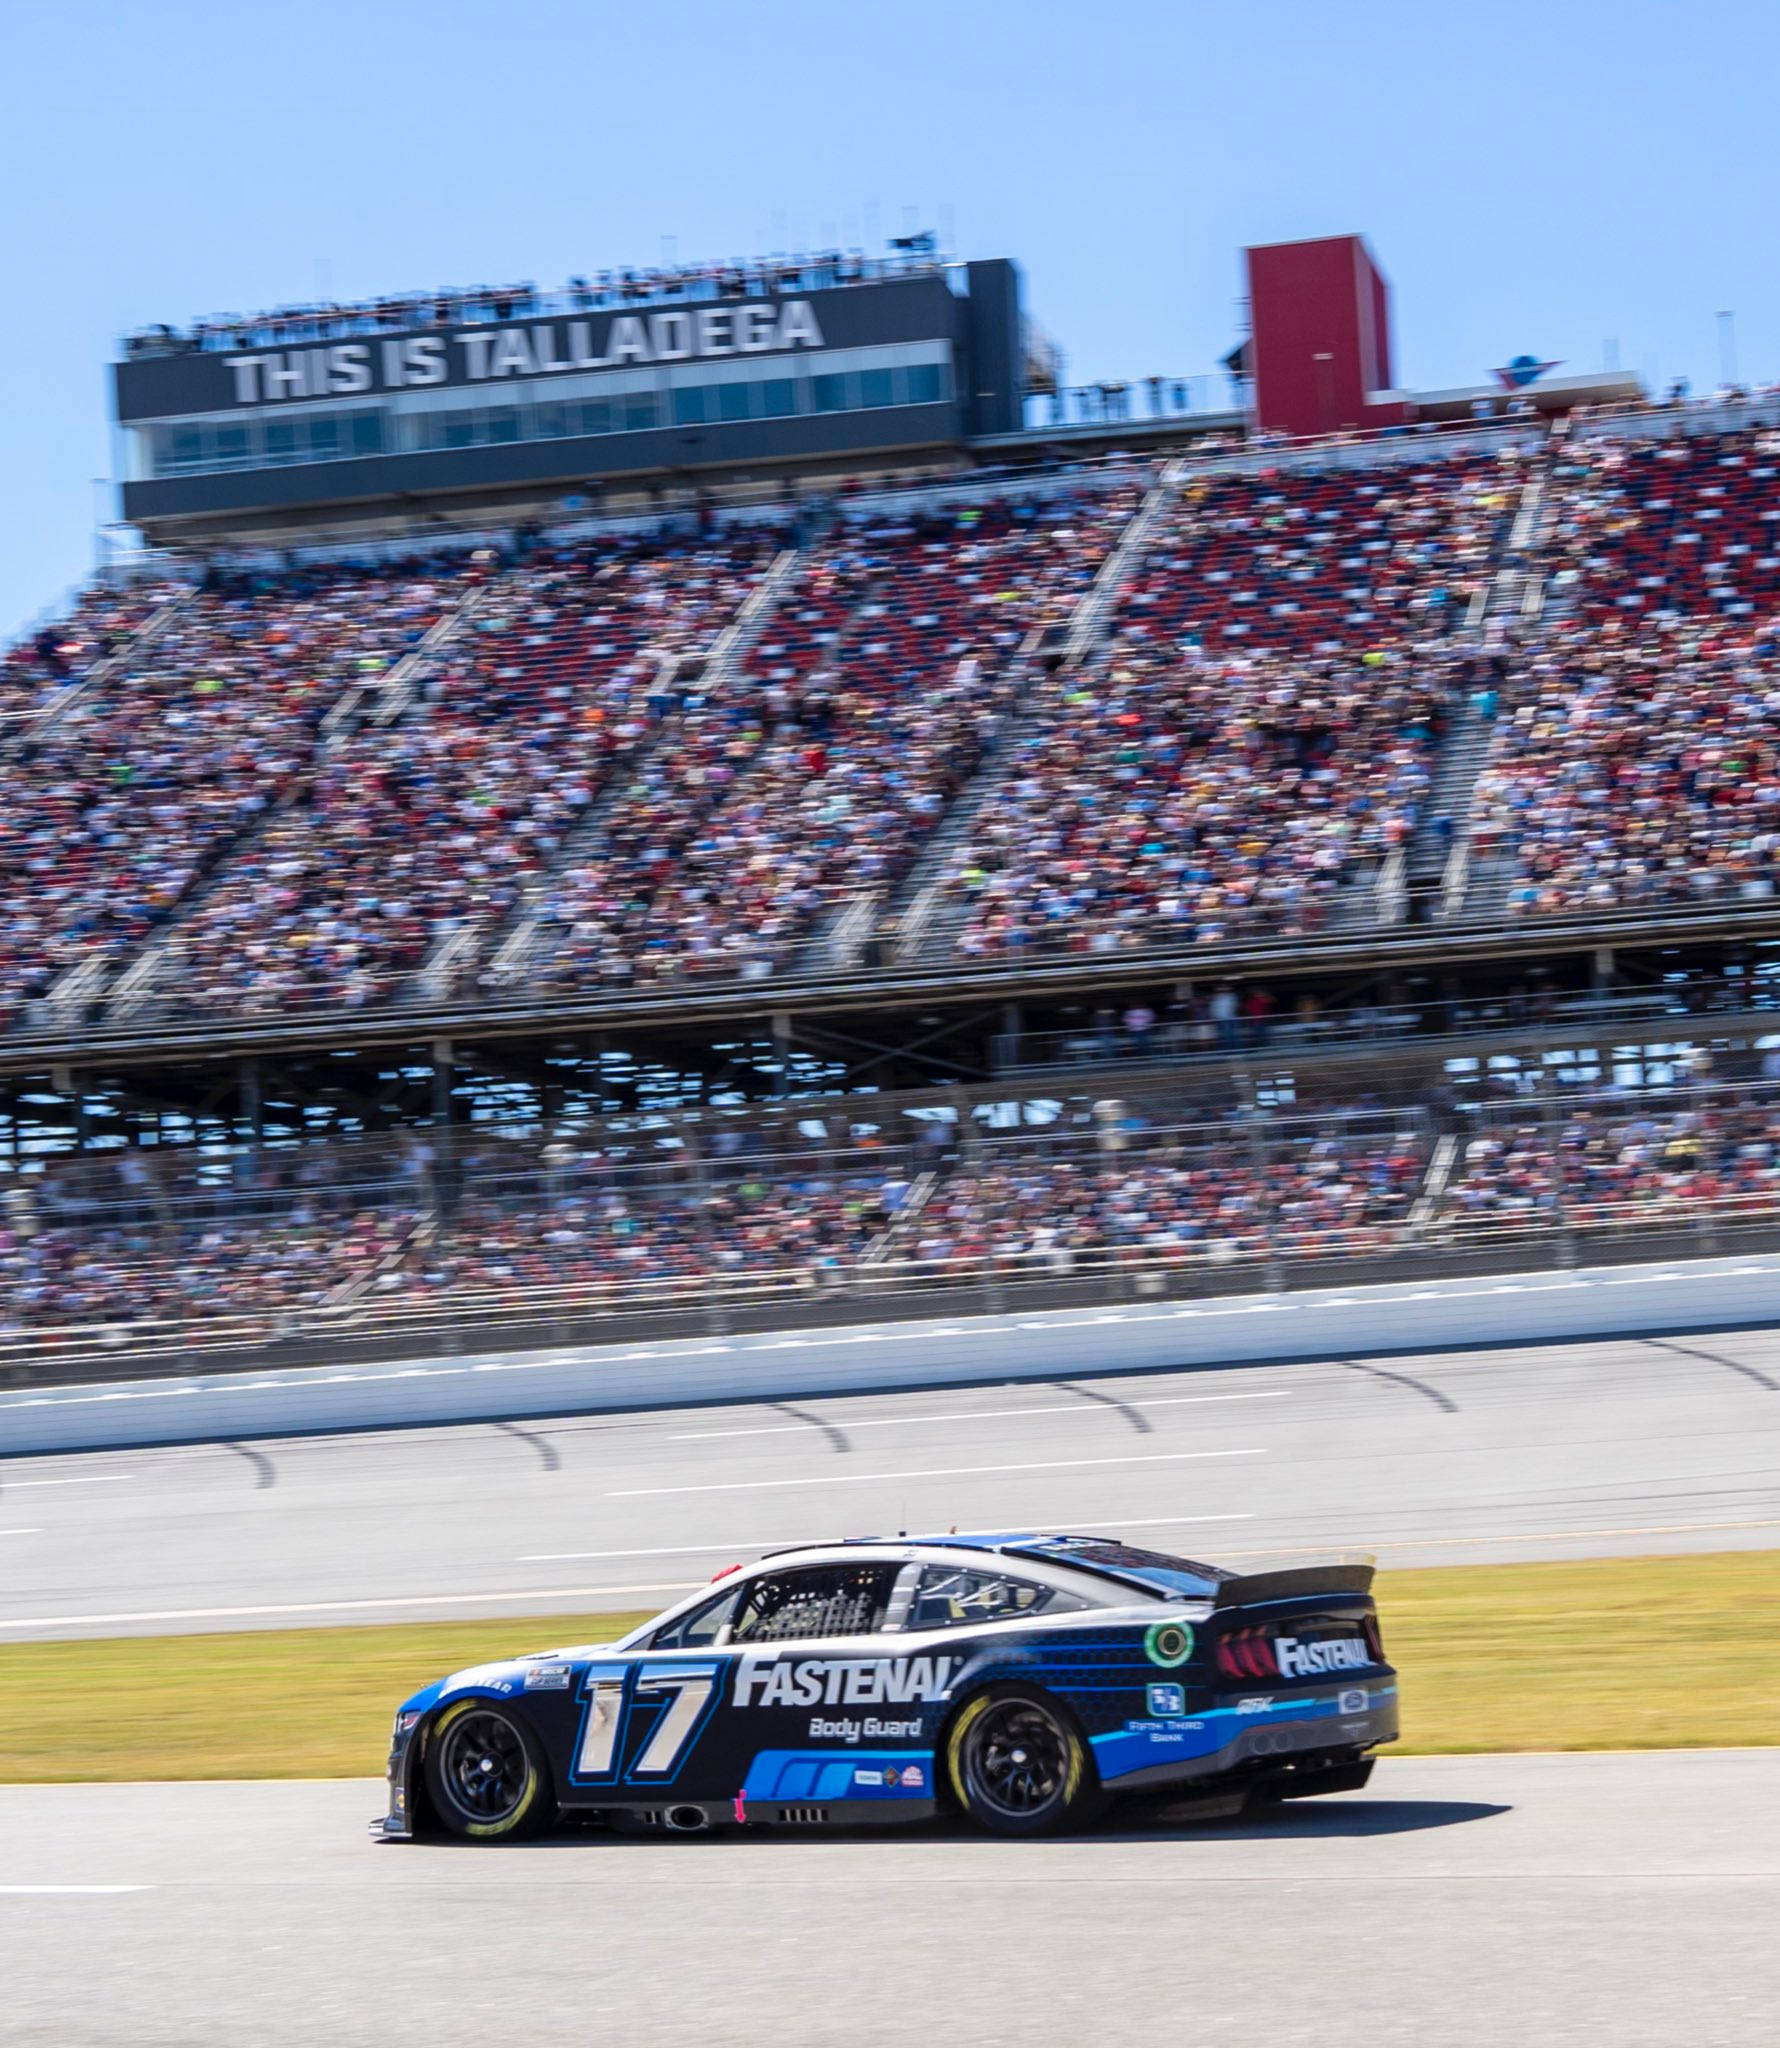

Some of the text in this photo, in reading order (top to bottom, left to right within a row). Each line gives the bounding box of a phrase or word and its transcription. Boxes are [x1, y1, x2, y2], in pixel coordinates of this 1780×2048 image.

[223, 300, 825, 402] THIS IS TALLADEGA
[731, 1653, 953, 1706] FASTENAL
[573, 1658, 729, 1783] 17
[809, 1718, 922, 1743] Body Guard
